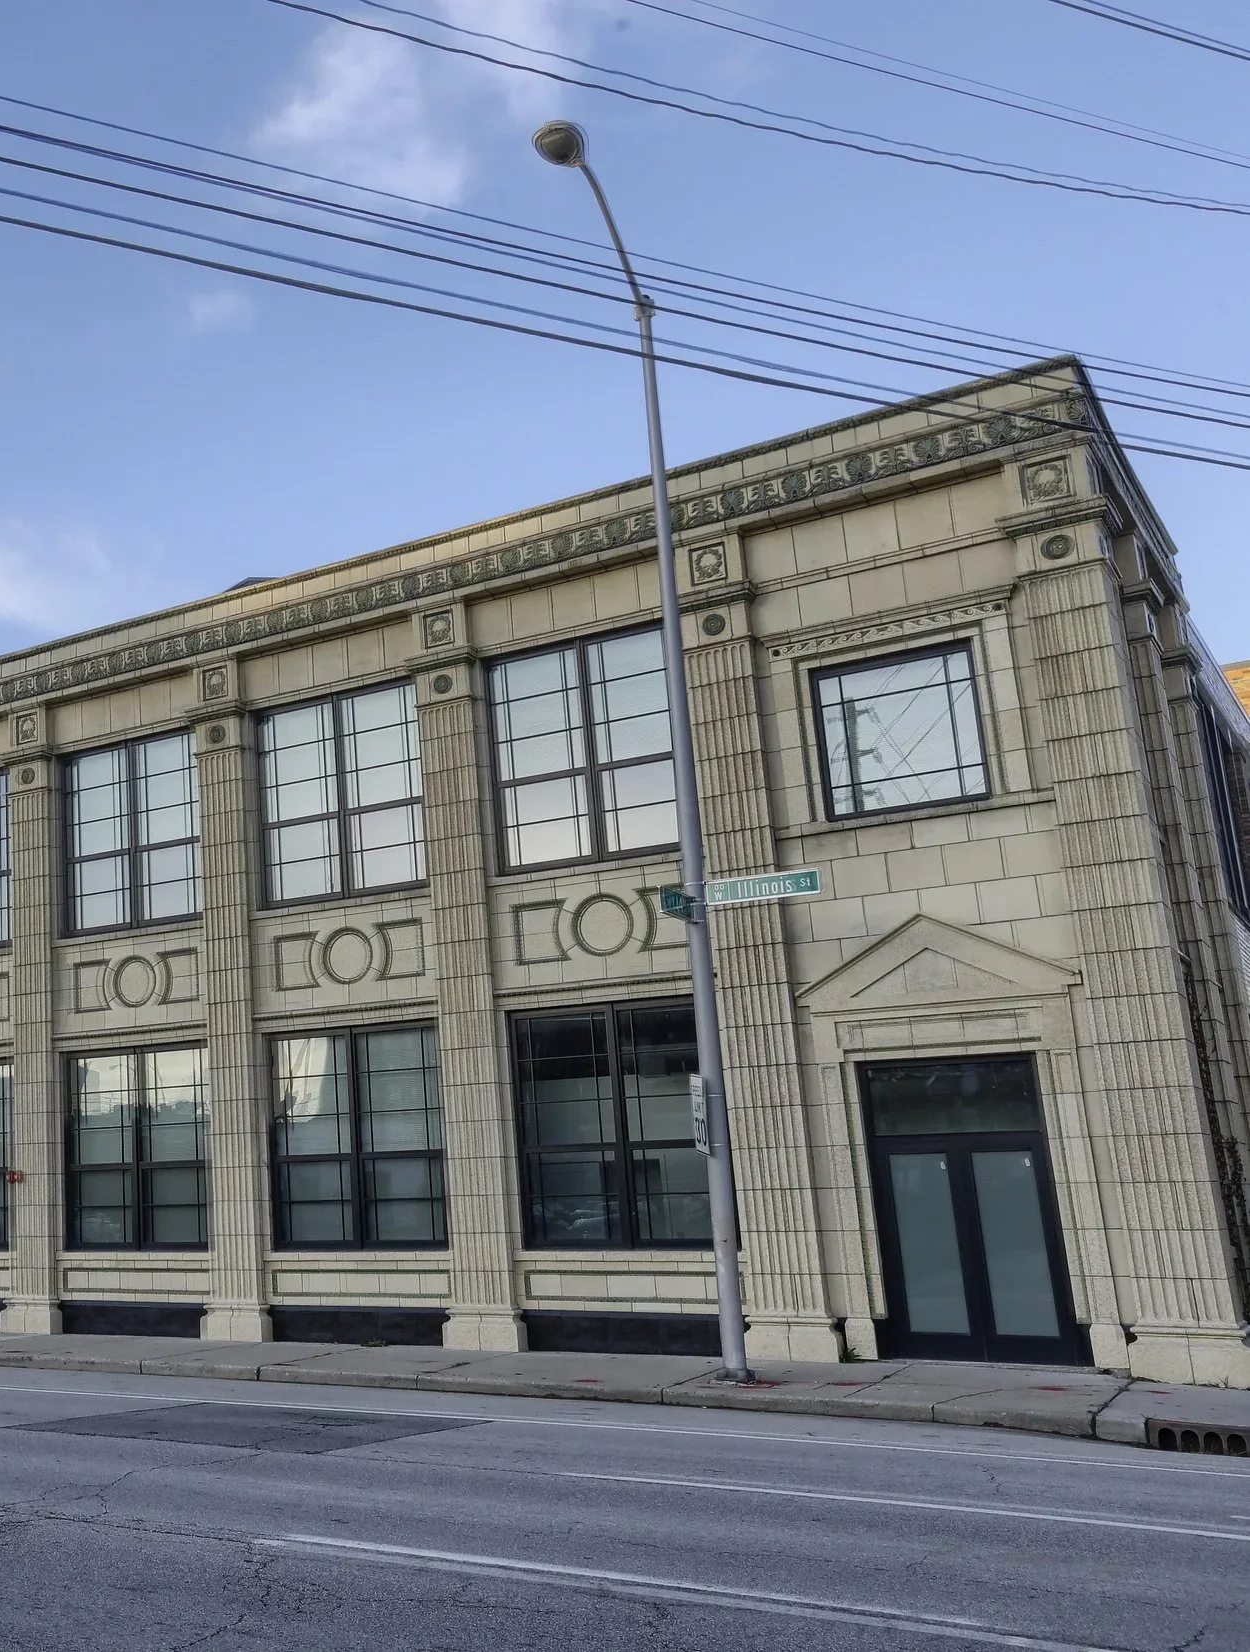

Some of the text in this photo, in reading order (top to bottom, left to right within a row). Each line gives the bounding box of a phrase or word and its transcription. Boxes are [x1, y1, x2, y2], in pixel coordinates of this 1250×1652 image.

[714, 892, 723, 901] W
[737, 876, 811, 898] Illinois St
[695, 1117, 706, 1146] 30
